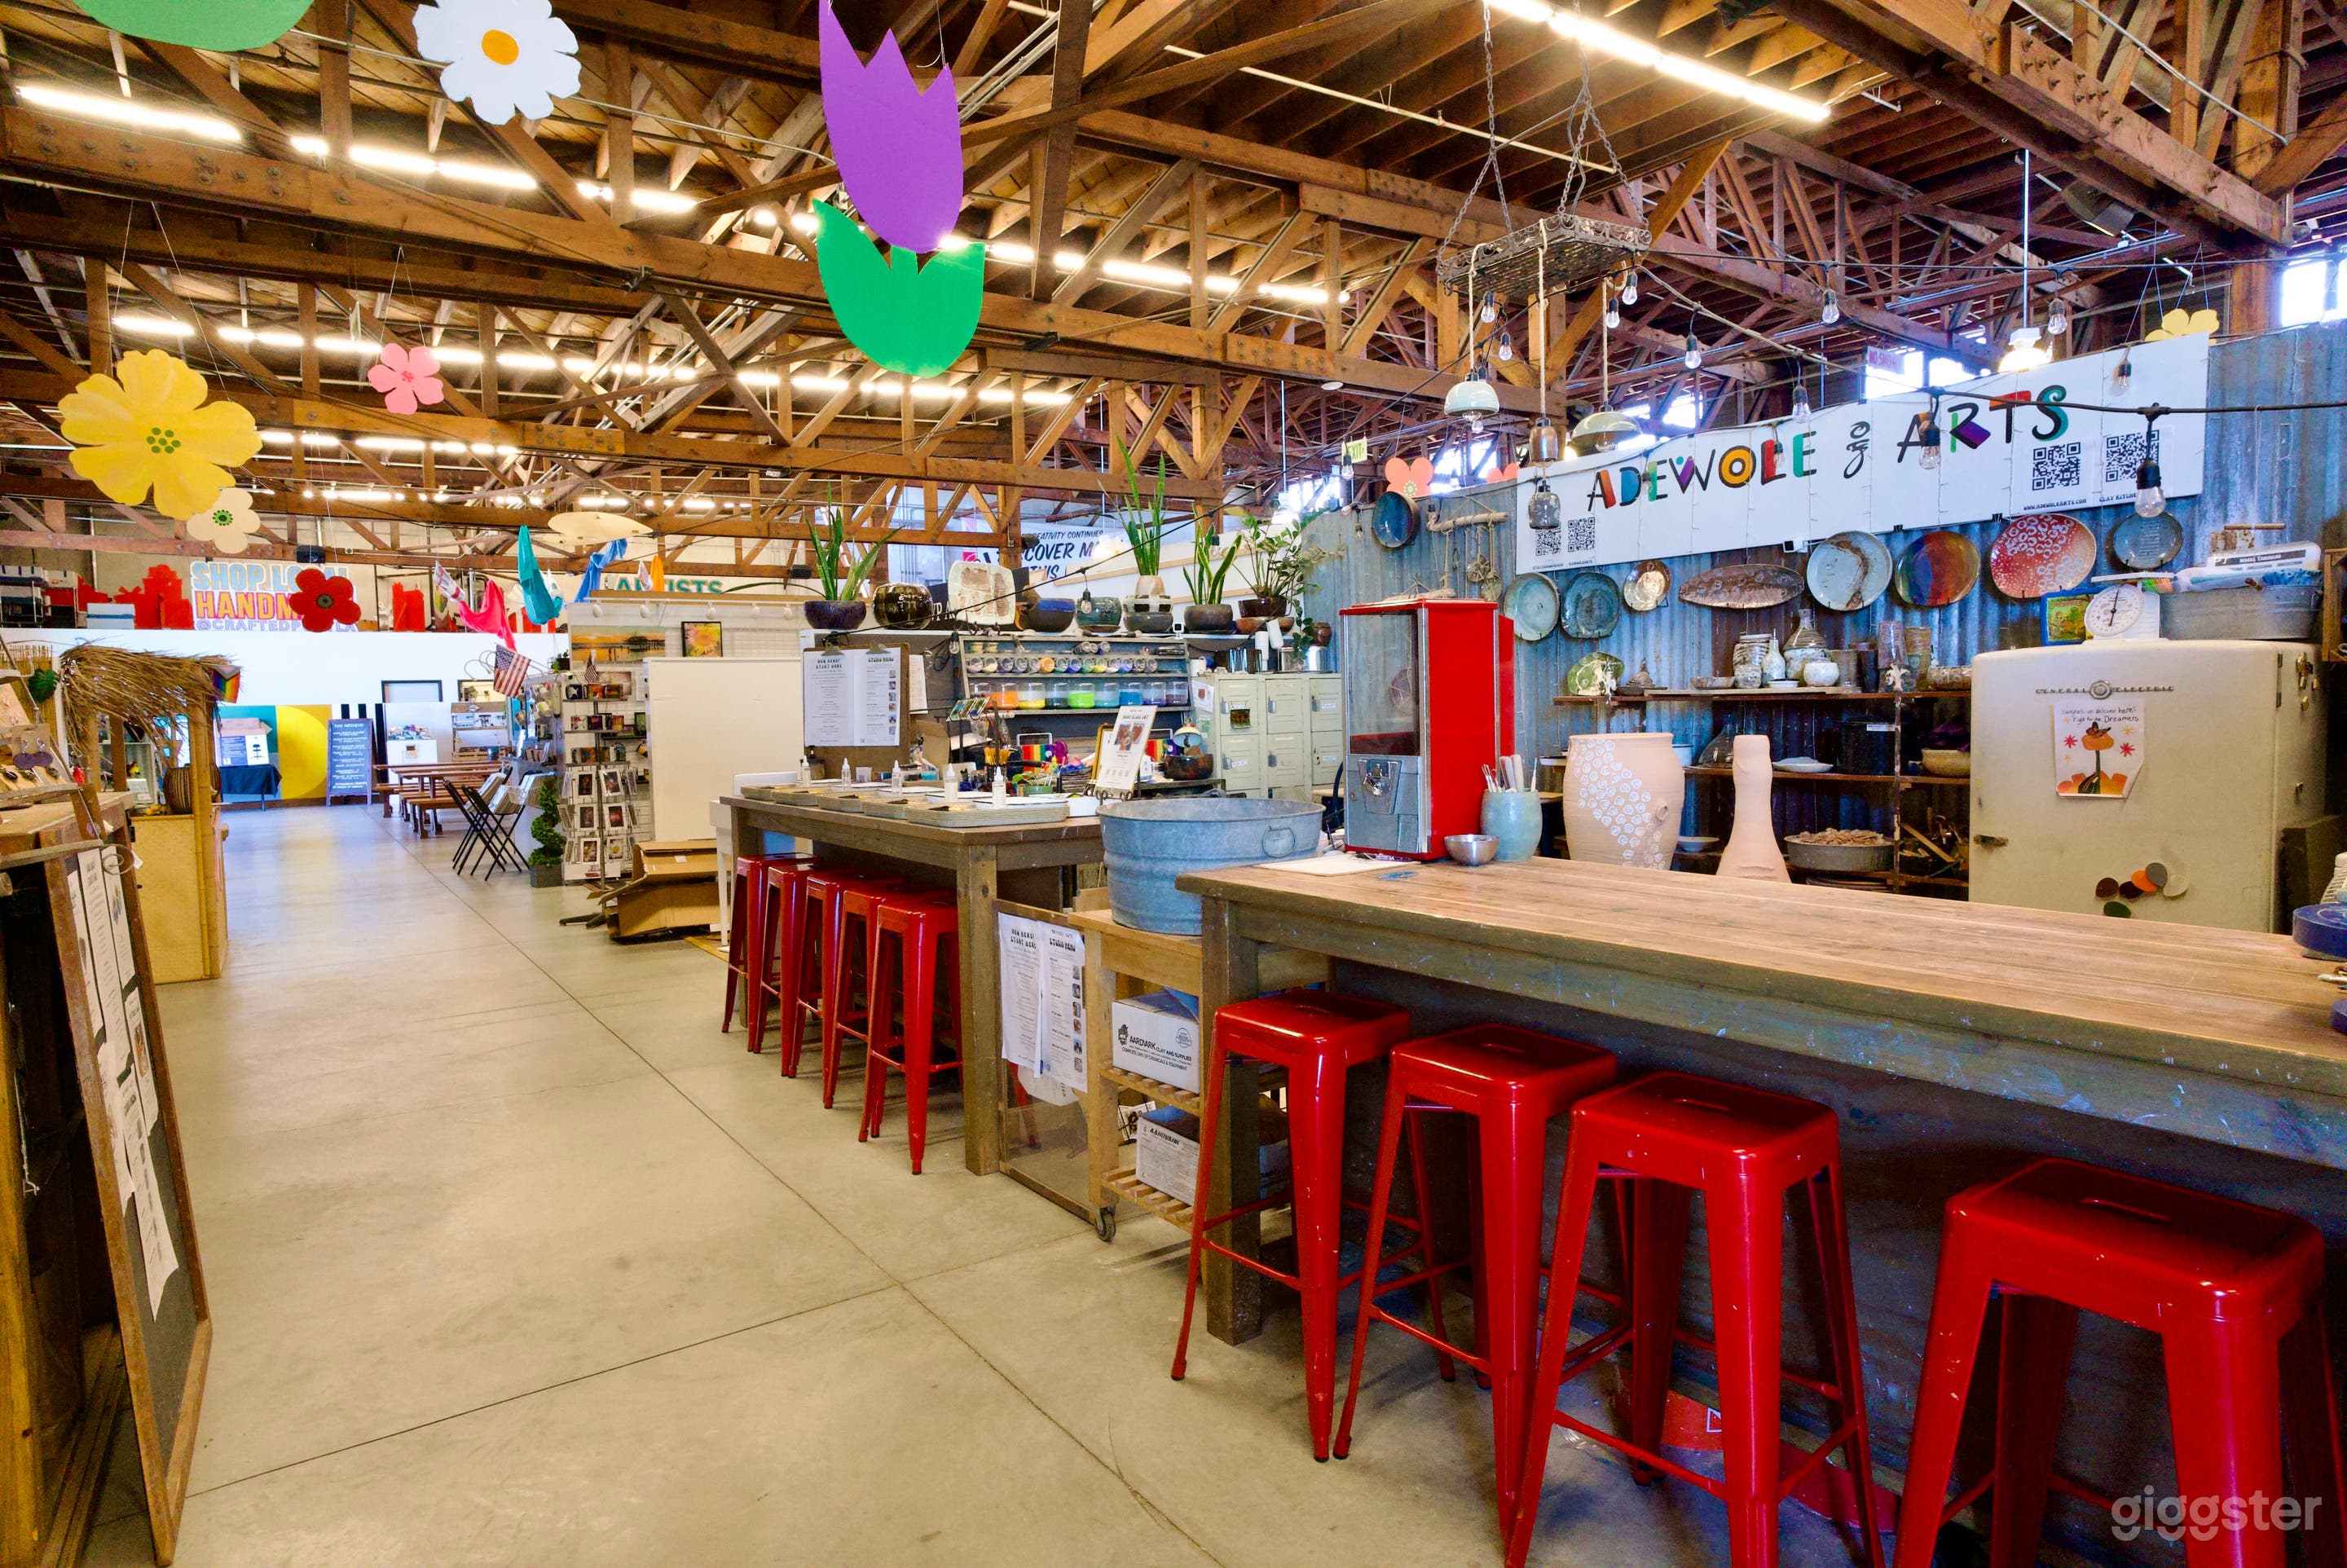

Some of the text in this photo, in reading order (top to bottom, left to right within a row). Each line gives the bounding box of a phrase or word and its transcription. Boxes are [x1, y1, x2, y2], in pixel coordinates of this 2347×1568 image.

[1587, 430, 1817, 512] ADEWOLE
[1897, 384, 2069, 463] ARTS
[2116, 492, 2138, 500] KITCHE
[1032, 531, 1066, 540] EATIVITY
[1022, 541, 1075, 562] COVER
[192, 562, 349, 592] SHOP LOA
[618, 576, 724, 594] AISTS
[194, 591, 354, 620] HANDM
[196, 619, 357, 632] @CRAFTEDPLA
